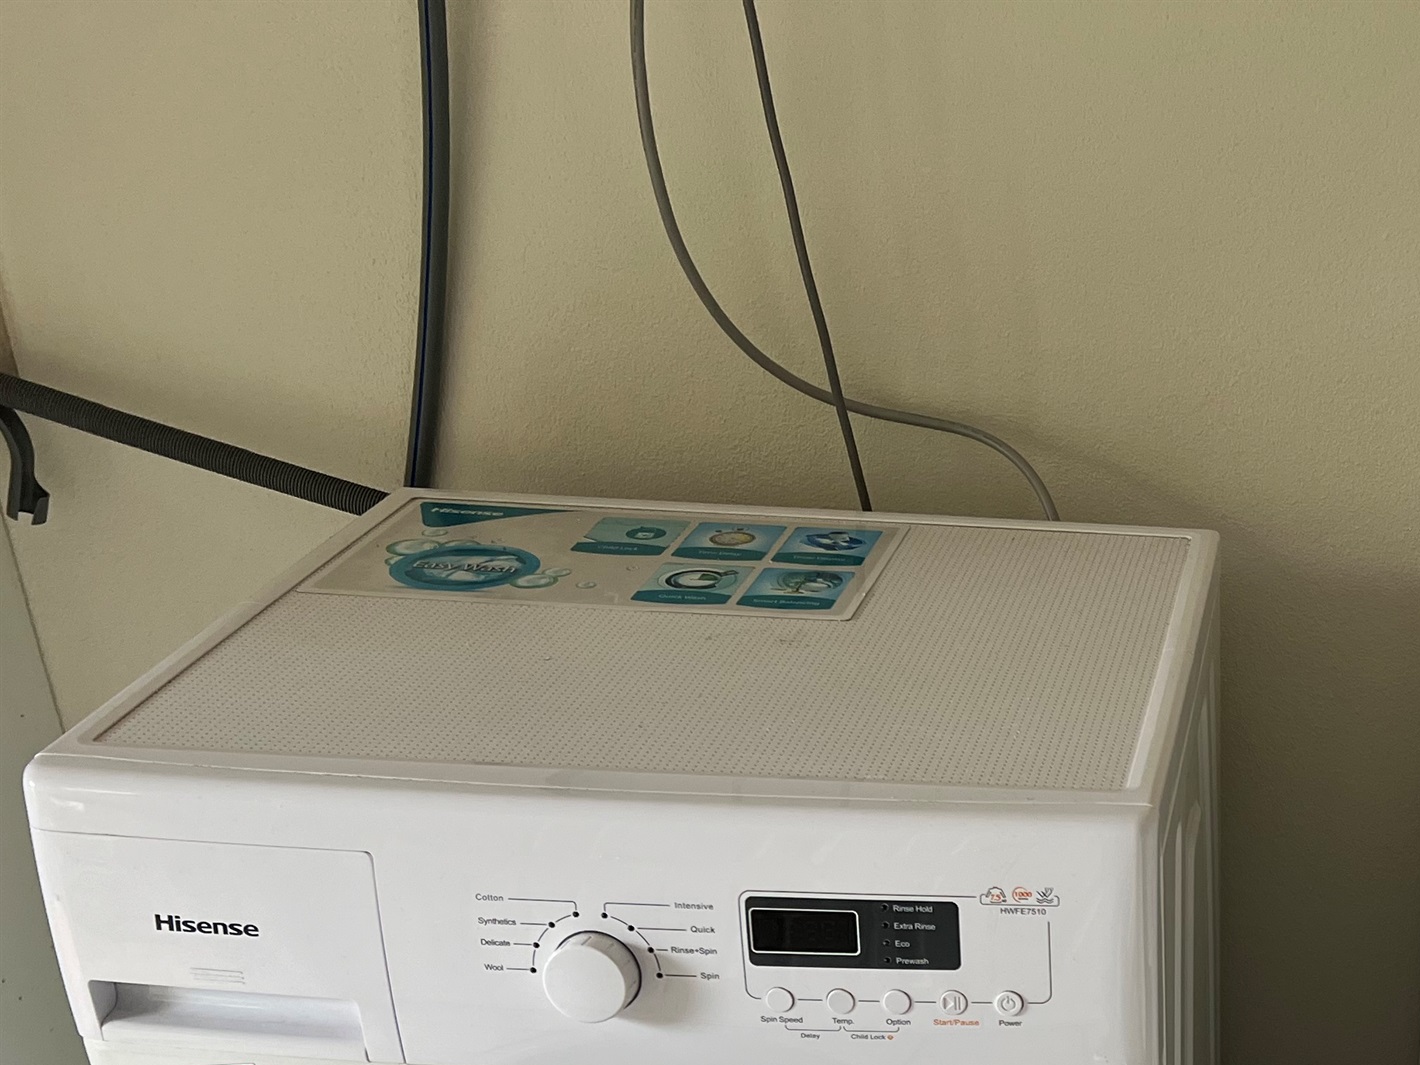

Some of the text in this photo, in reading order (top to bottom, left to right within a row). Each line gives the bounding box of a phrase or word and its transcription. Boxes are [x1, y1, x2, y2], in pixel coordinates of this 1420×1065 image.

[431, 507, 504, 516] Hisense
[412, 560, 518, 574] Easy Wash
[475, 893, 504, 902] Cotton
[674, 902, 714, 911] Intensive
[893, 904, 933, 914] Rinse Hold
[1000, 907, 1047, 916] HWFE7510
[154, 914, 260, 937] Hisense
[478, 916, 516, 927] Synthetics
[690, 926, 716, 935] Quick
[893, 921, 936, 932] Extra Rinse
[480, 938, 511, 946] Delicate
[895, 939, 910, 948] Eco
[896, 956, 929, 966] Prewash
[484, 963, 504, 972] Wool
[700, 972, 720, 981] Spin
[760, 1016, 804, 1024] Spin Speed
[832, 1017, 854, 1026] Temp.
[886, 1018, 912, 1026] Option
[933, 1018, 980, 1027] Start/Pause
[998, 1019, 1022, 1027] Power
[801, 1032, 821, 1040] Delay
